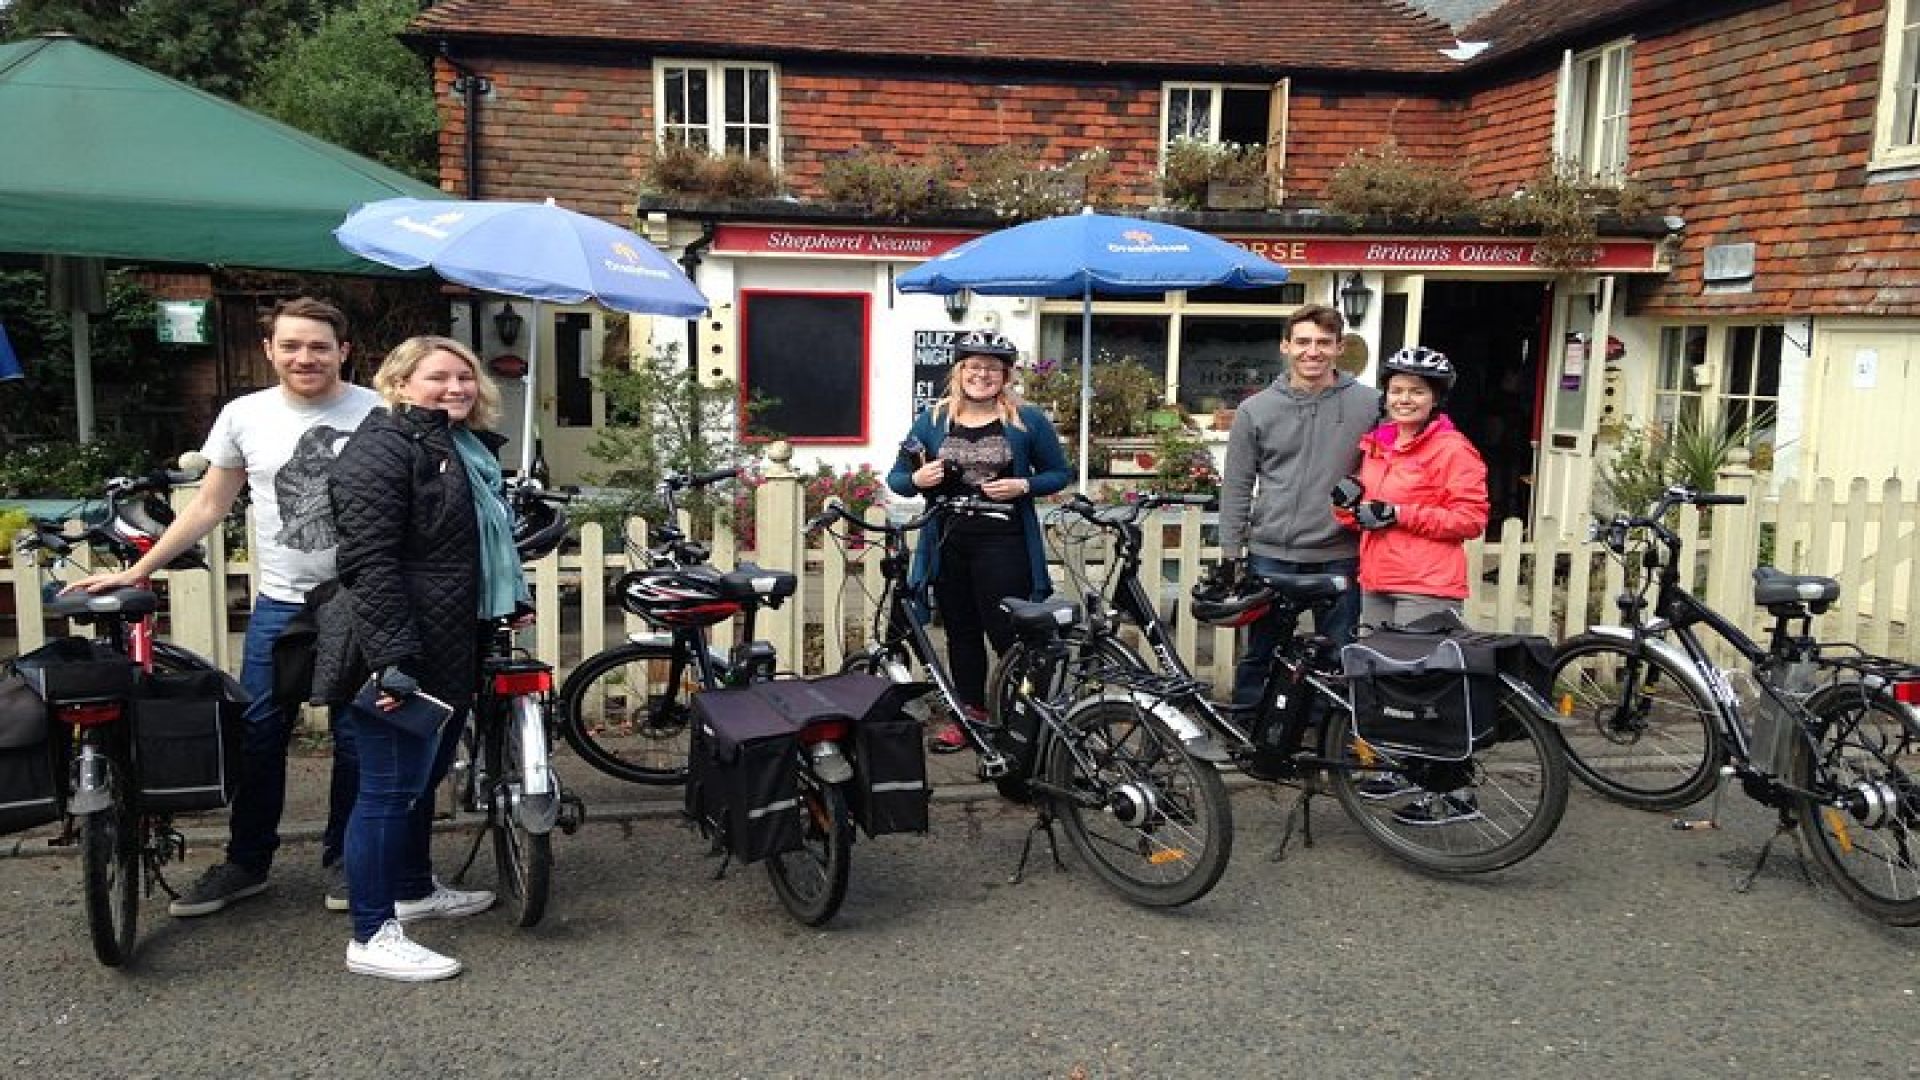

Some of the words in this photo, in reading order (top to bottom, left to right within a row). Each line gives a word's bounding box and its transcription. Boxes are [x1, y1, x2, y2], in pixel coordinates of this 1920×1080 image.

[767, 232, 865, 251] Shepherd
[869, 235, 933, 252] Neame
[1366, 244, 1450, 262] Britain's
[1461, 245, 1522, 262] Oldest
[915, 332, 956, 348] QUIZ
[915, 347, 956, 365] NIGH
